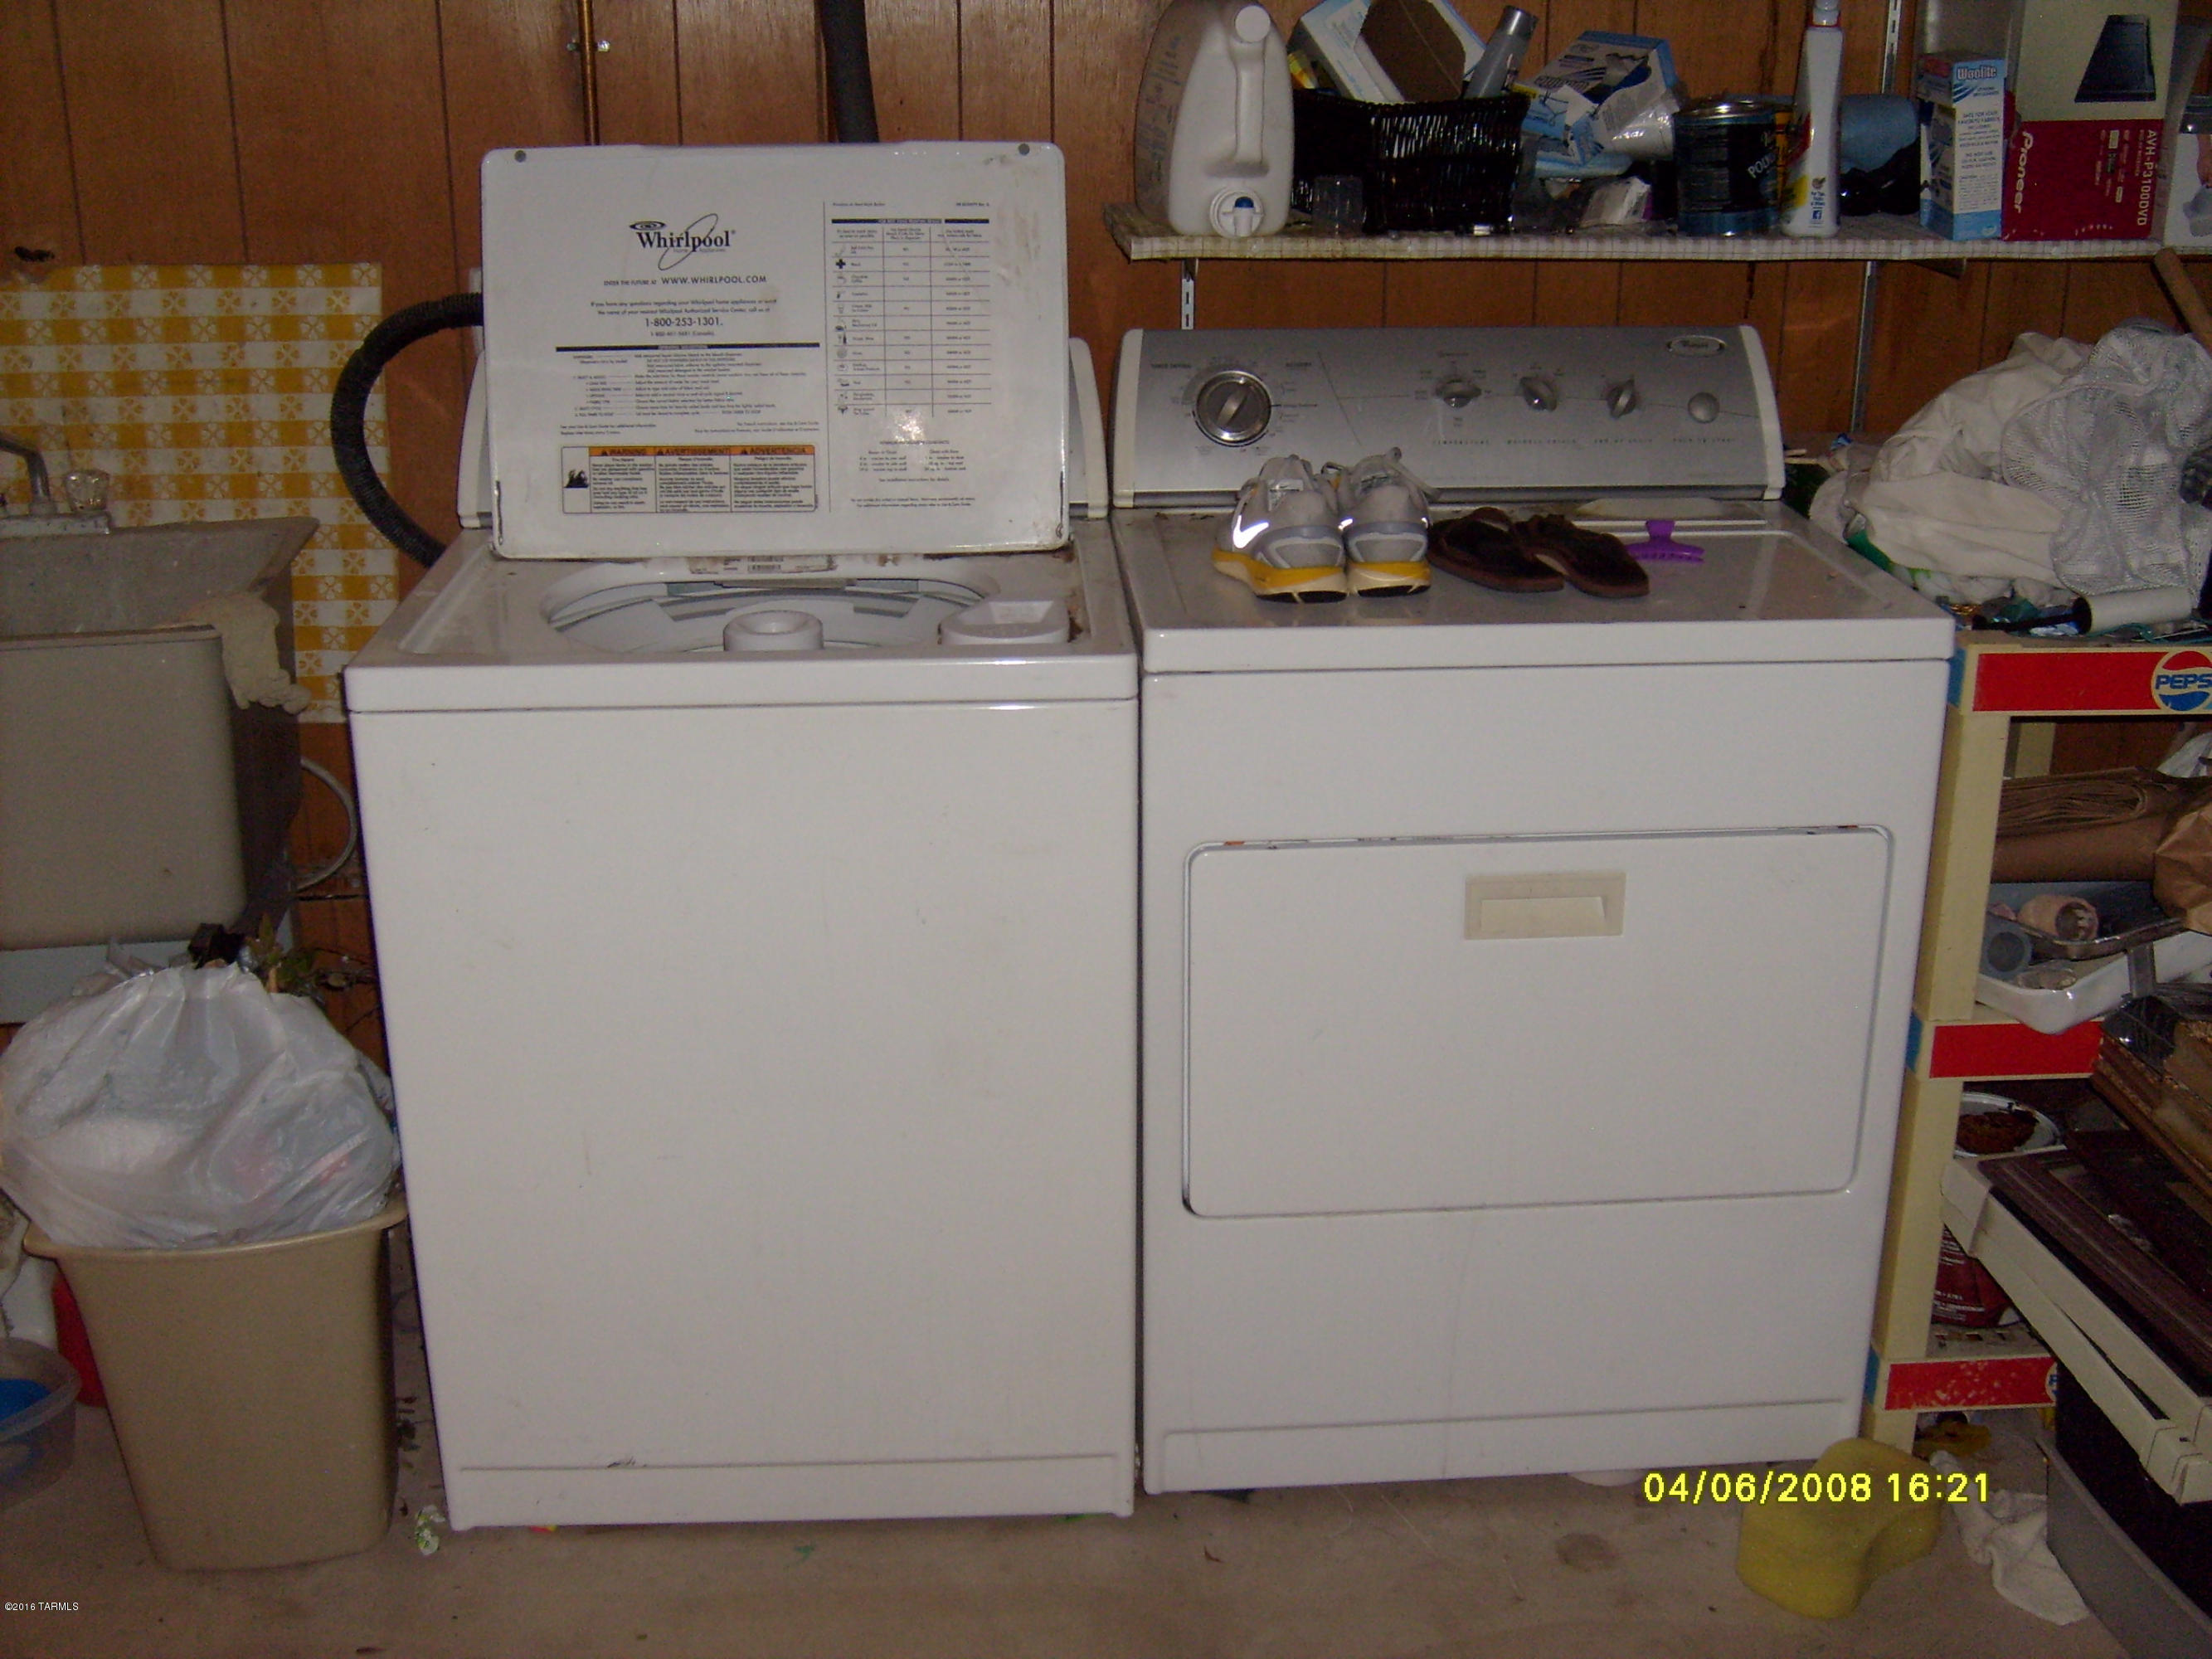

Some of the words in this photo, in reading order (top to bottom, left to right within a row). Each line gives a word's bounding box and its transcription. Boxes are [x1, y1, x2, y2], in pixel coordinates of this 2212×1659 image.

[1957, 66, 1997, 80] Woolite
[2014, 131, 2034, 214] Pioneer
[2137, 129, 2157, 226] AVH-P3100DVD
[636, 229, 731, 252] Whirlpool
[661, 275, 767, 285] WWW.WHIRLPOOL.COM
